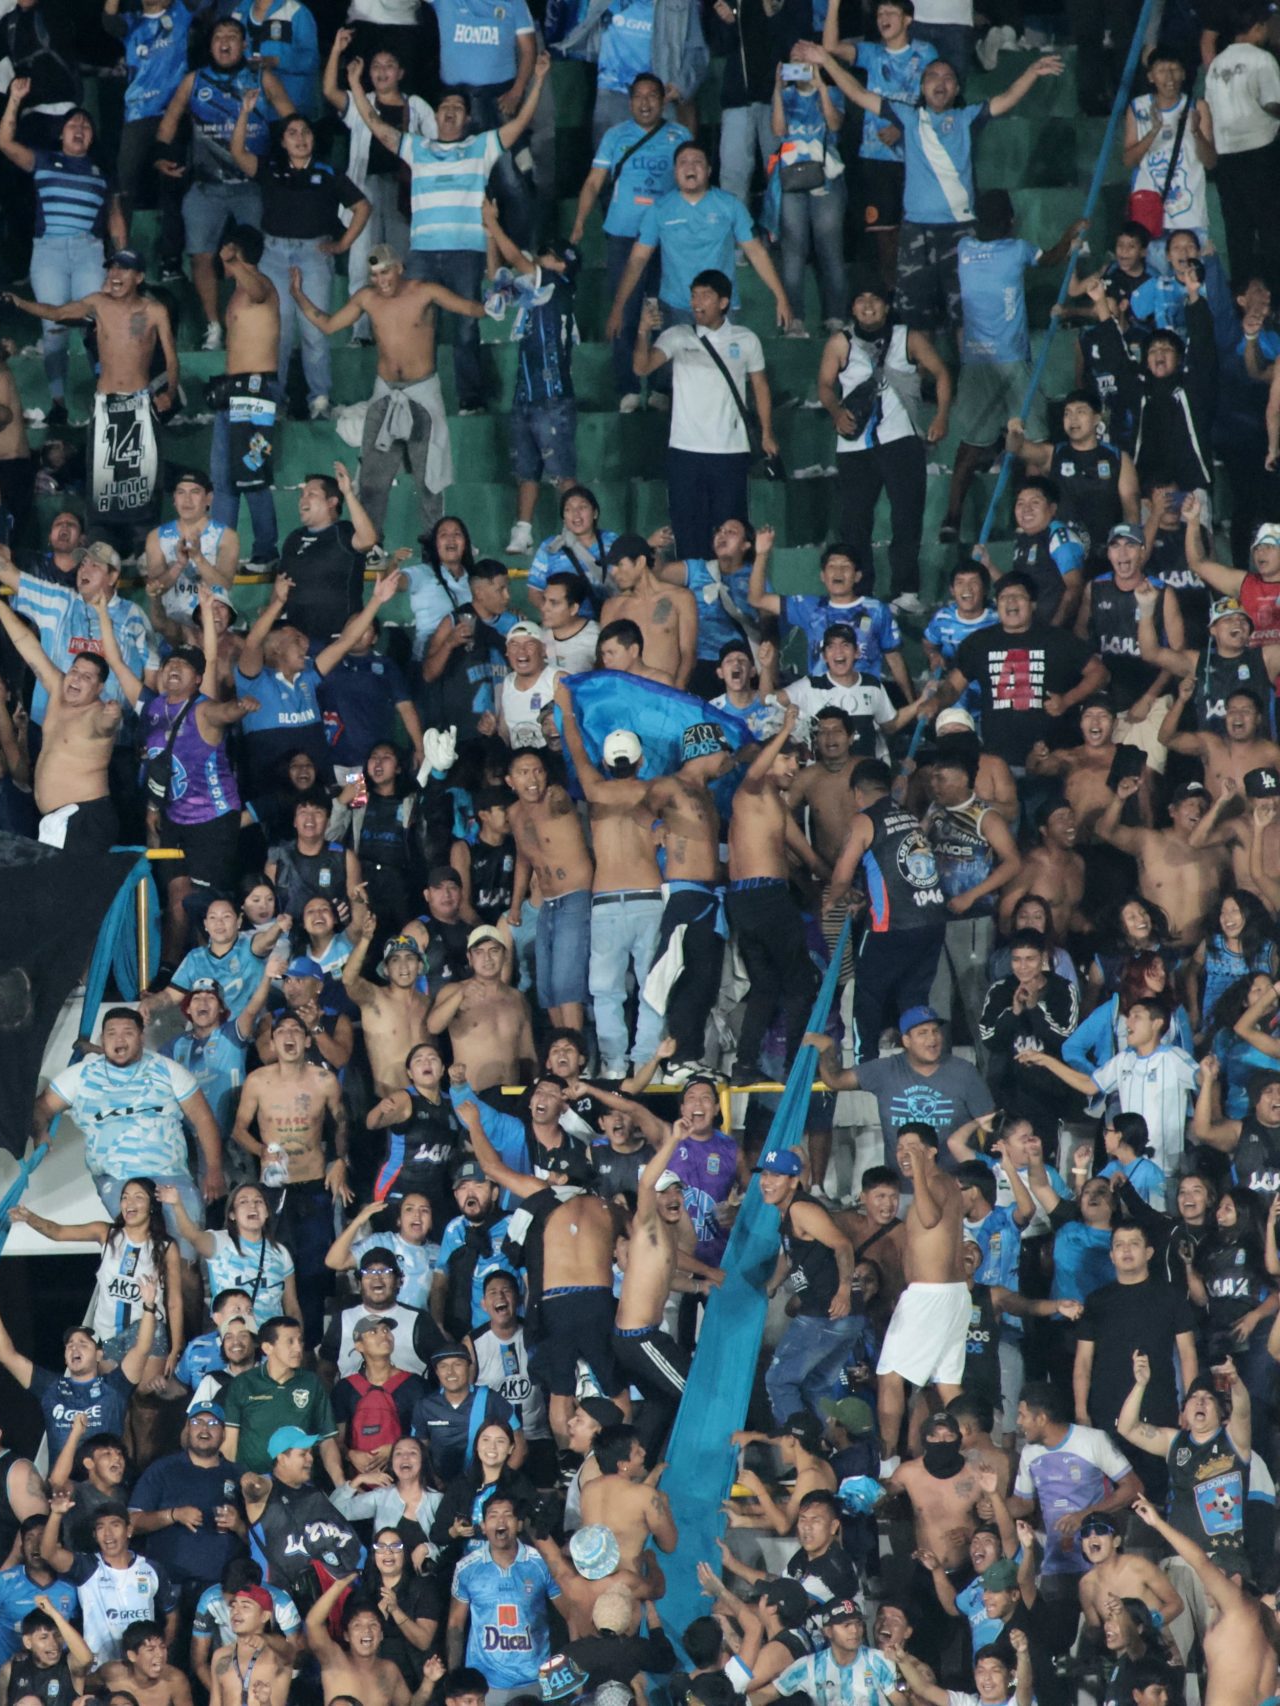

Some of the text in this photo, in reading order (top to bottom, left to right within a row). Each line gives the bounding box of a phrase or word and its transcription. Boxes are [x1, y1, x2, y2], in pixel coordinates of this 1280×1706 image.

[453, 23, 500, 46] HONDA
[102, 419, 146, 470] 14
[99, 477, 150, 498] JUNTO
[98, 496, 112, 512] A
[1260, 771, 1277, 789] LA
[913, 888, 945, 908] 1946
[577, 1097, 592, 1112] 23
[108, 1278, 141, 1299] AKD
[499, 1378, 530, 1398] AKD
[120, 1609, 151, 1620] GREE
[483, 1624, 533, 1652] Ducal
[550, 1667, 576, 1689] 46
